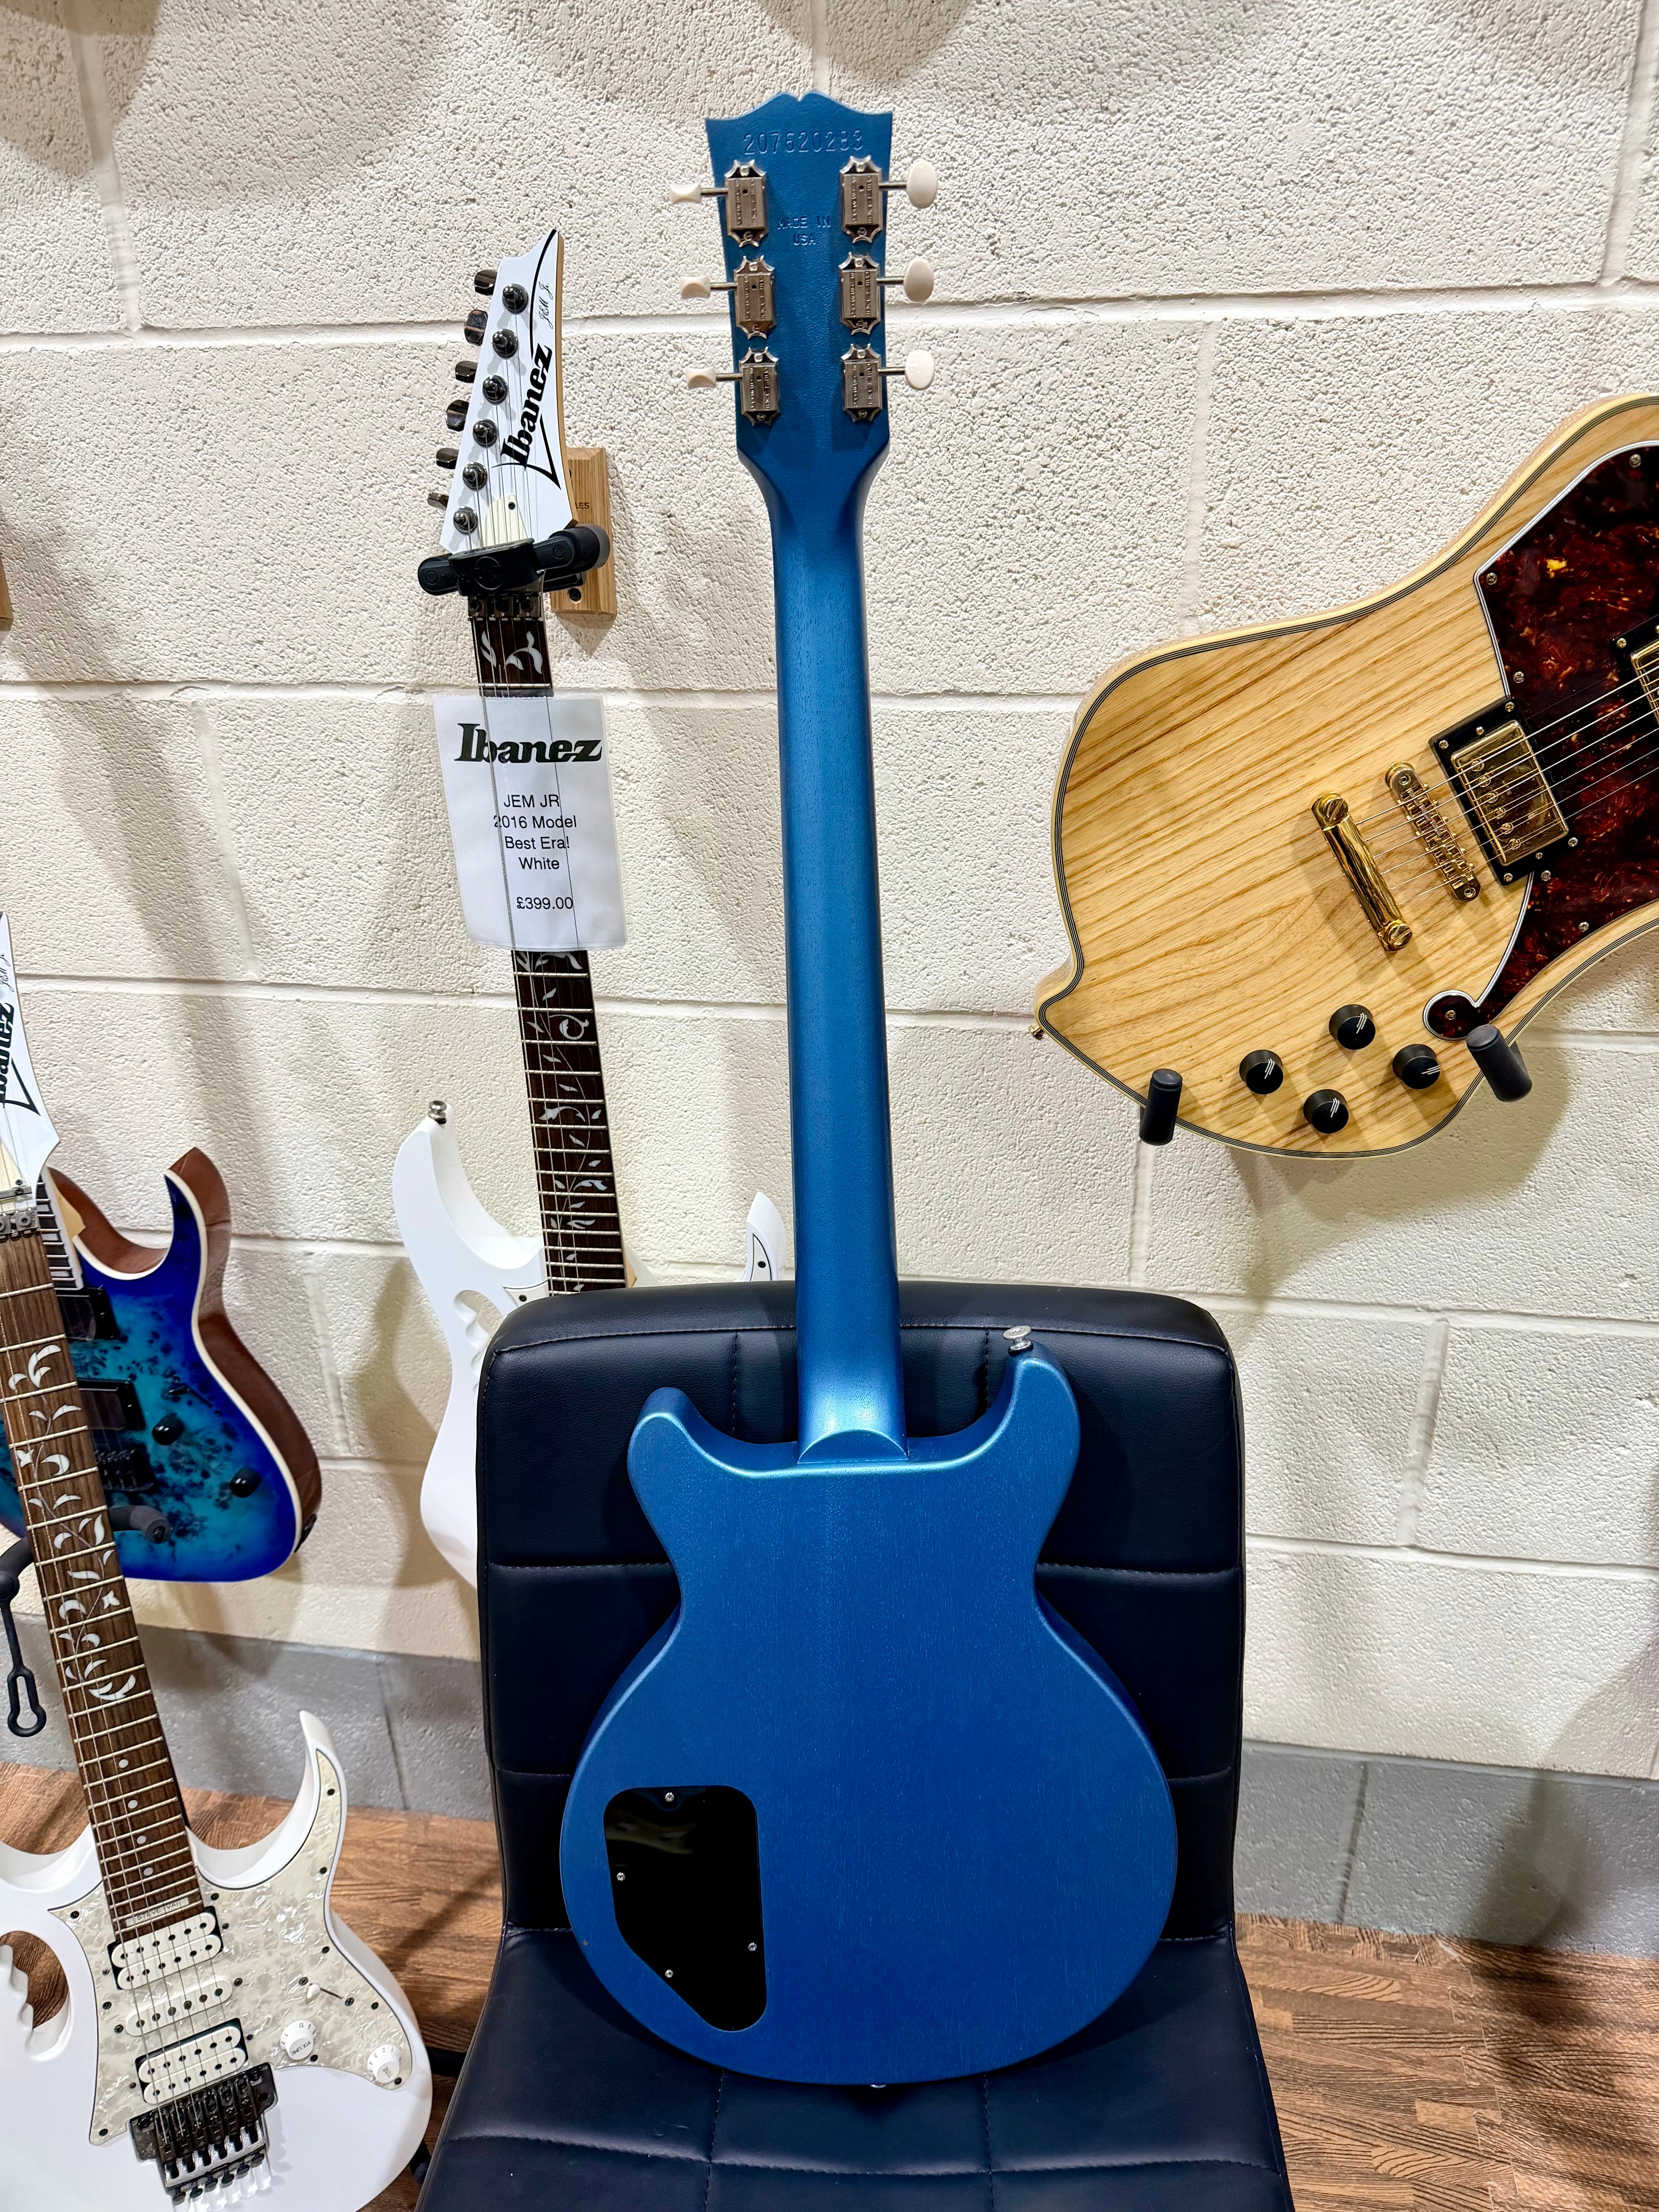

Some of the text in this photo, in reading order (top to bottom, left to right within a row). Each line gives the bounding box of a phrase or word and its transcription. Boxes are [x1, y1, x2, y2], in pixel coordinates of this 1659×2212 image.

[778, 215, 831, 230] MADE IN
[793, 234, 816, 246] USA
[500, 342, 552, 472] Ibanez
[454, 723, 602, 764] Ibanez
[504, 794, 560, 808] JEM JR
[493, 815, 577, 828] 2016 Model
[505, 836, 570, 849] Best Era!
[519, 857, 560, 870] White
[517, 897, 574, 910] £399.00
[137, 1901, 179, 1921] STEVE VAI
[289, 2040, 312, 2057] VOLUME
